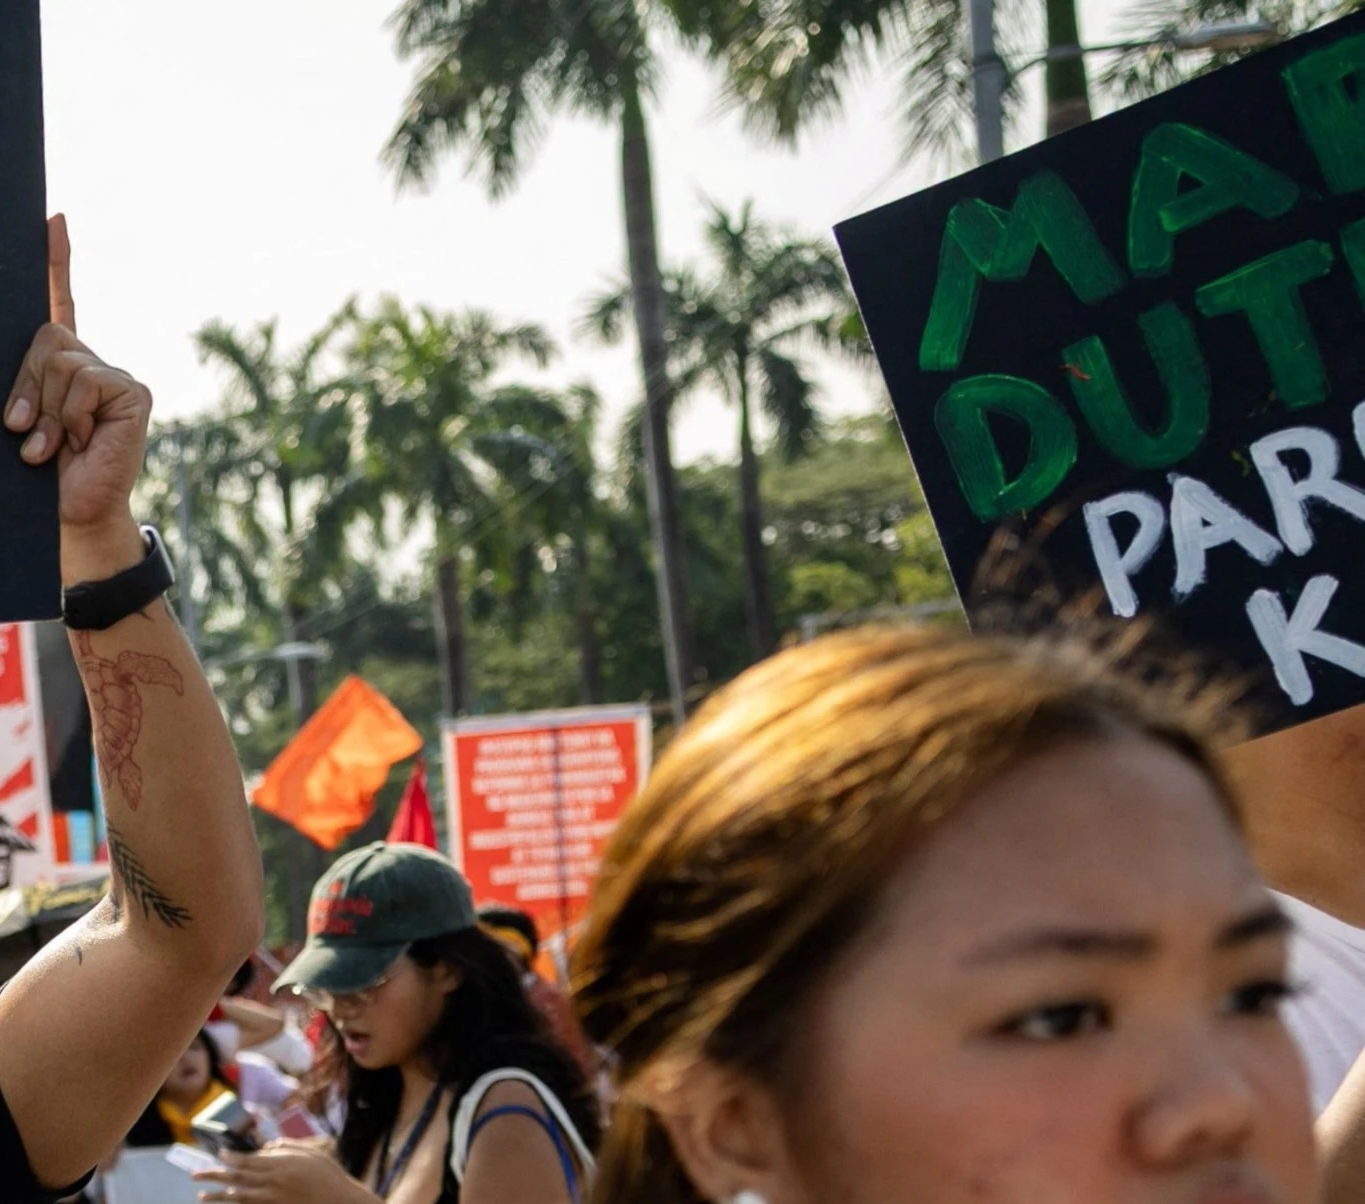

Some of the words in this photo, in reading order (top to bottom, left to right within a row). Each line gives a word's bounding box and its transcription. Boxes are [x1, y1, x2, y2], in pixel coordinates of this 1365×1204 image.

[919, 32, 1365, 371] MAR
[935, 218, 1365, 522] DUT
[1083, 400, 1365, 617] PAR
